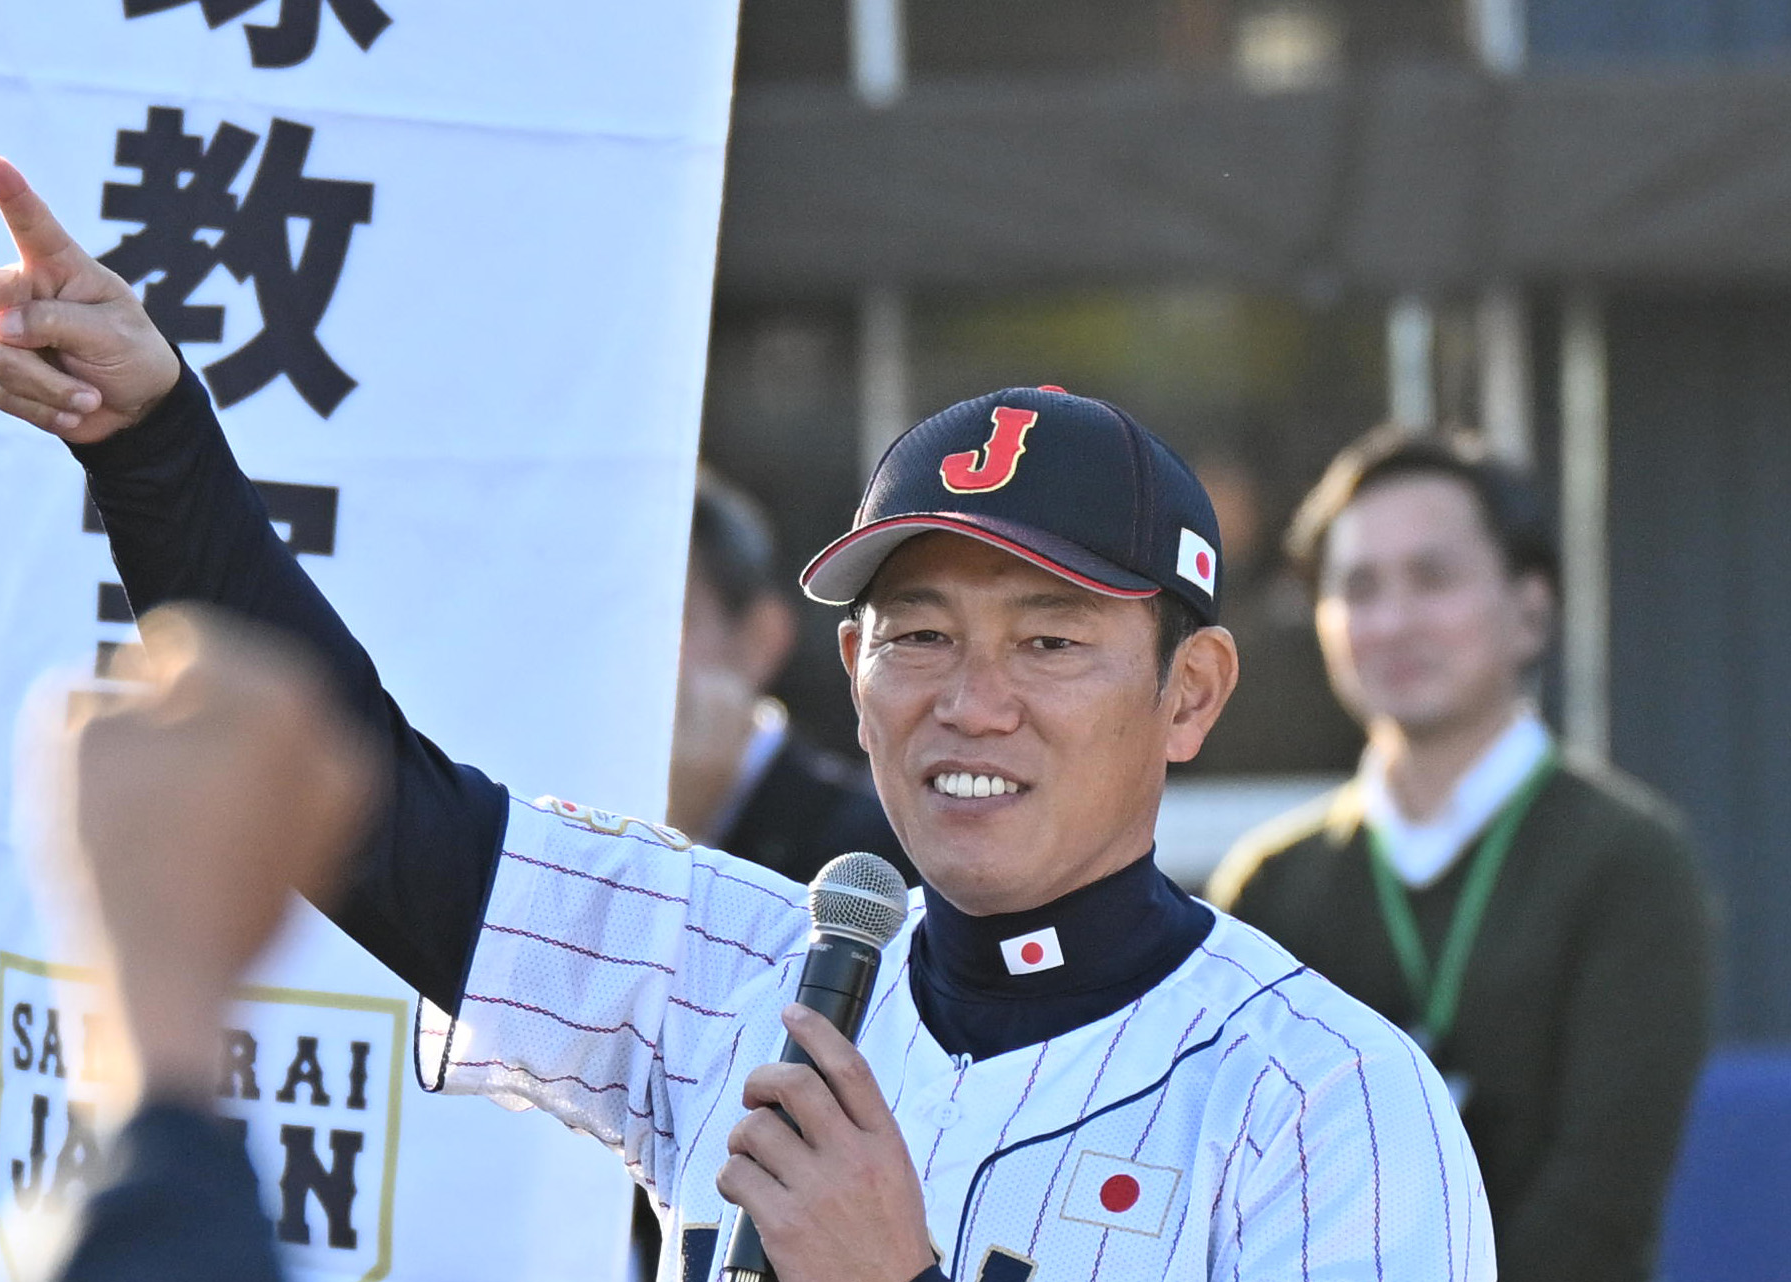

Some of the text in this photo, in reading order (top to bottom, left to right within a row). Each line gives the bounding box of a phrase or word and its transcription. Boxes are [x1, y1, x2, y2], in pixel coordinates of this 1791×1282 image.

[939, 405, 1039, 495] J
[11, 1002, 371, 1110] SARAI
[10, 1093, 365, 1250] JAN
